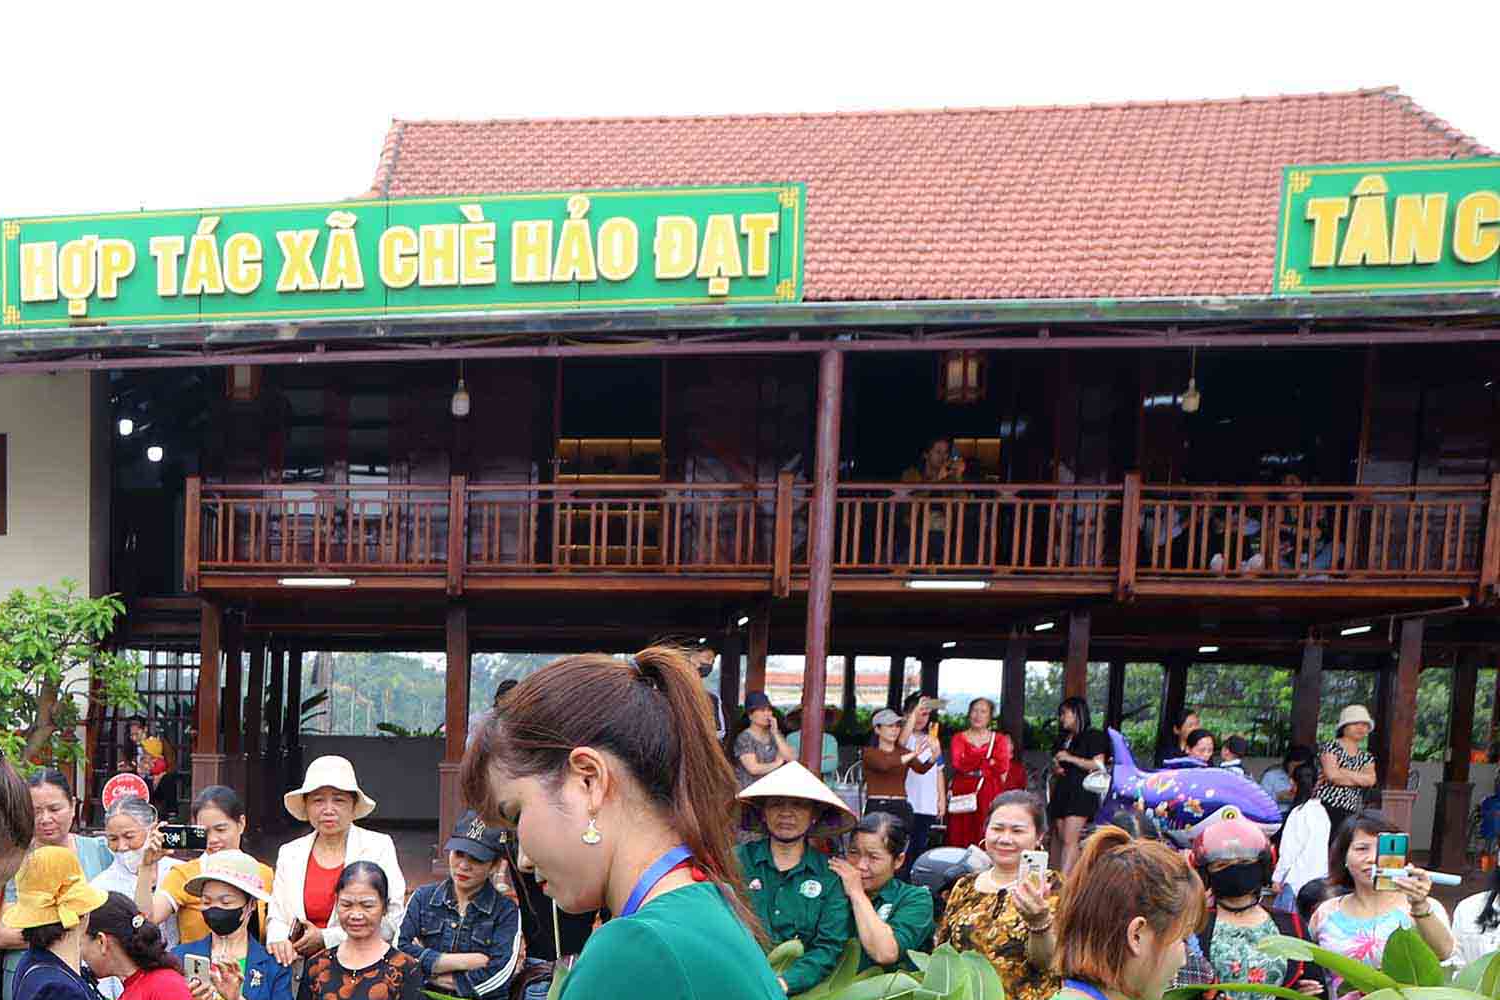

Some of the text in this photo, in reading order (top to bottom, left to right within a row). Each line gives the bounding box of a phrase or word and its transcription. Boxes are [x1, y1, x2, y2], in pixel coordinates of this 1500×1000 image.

[19, 194, 780, 316] HỢP TÁC XÃ CHÈ HẢO ĐẠT
[1305, 175, 1448, 267] TÂN
